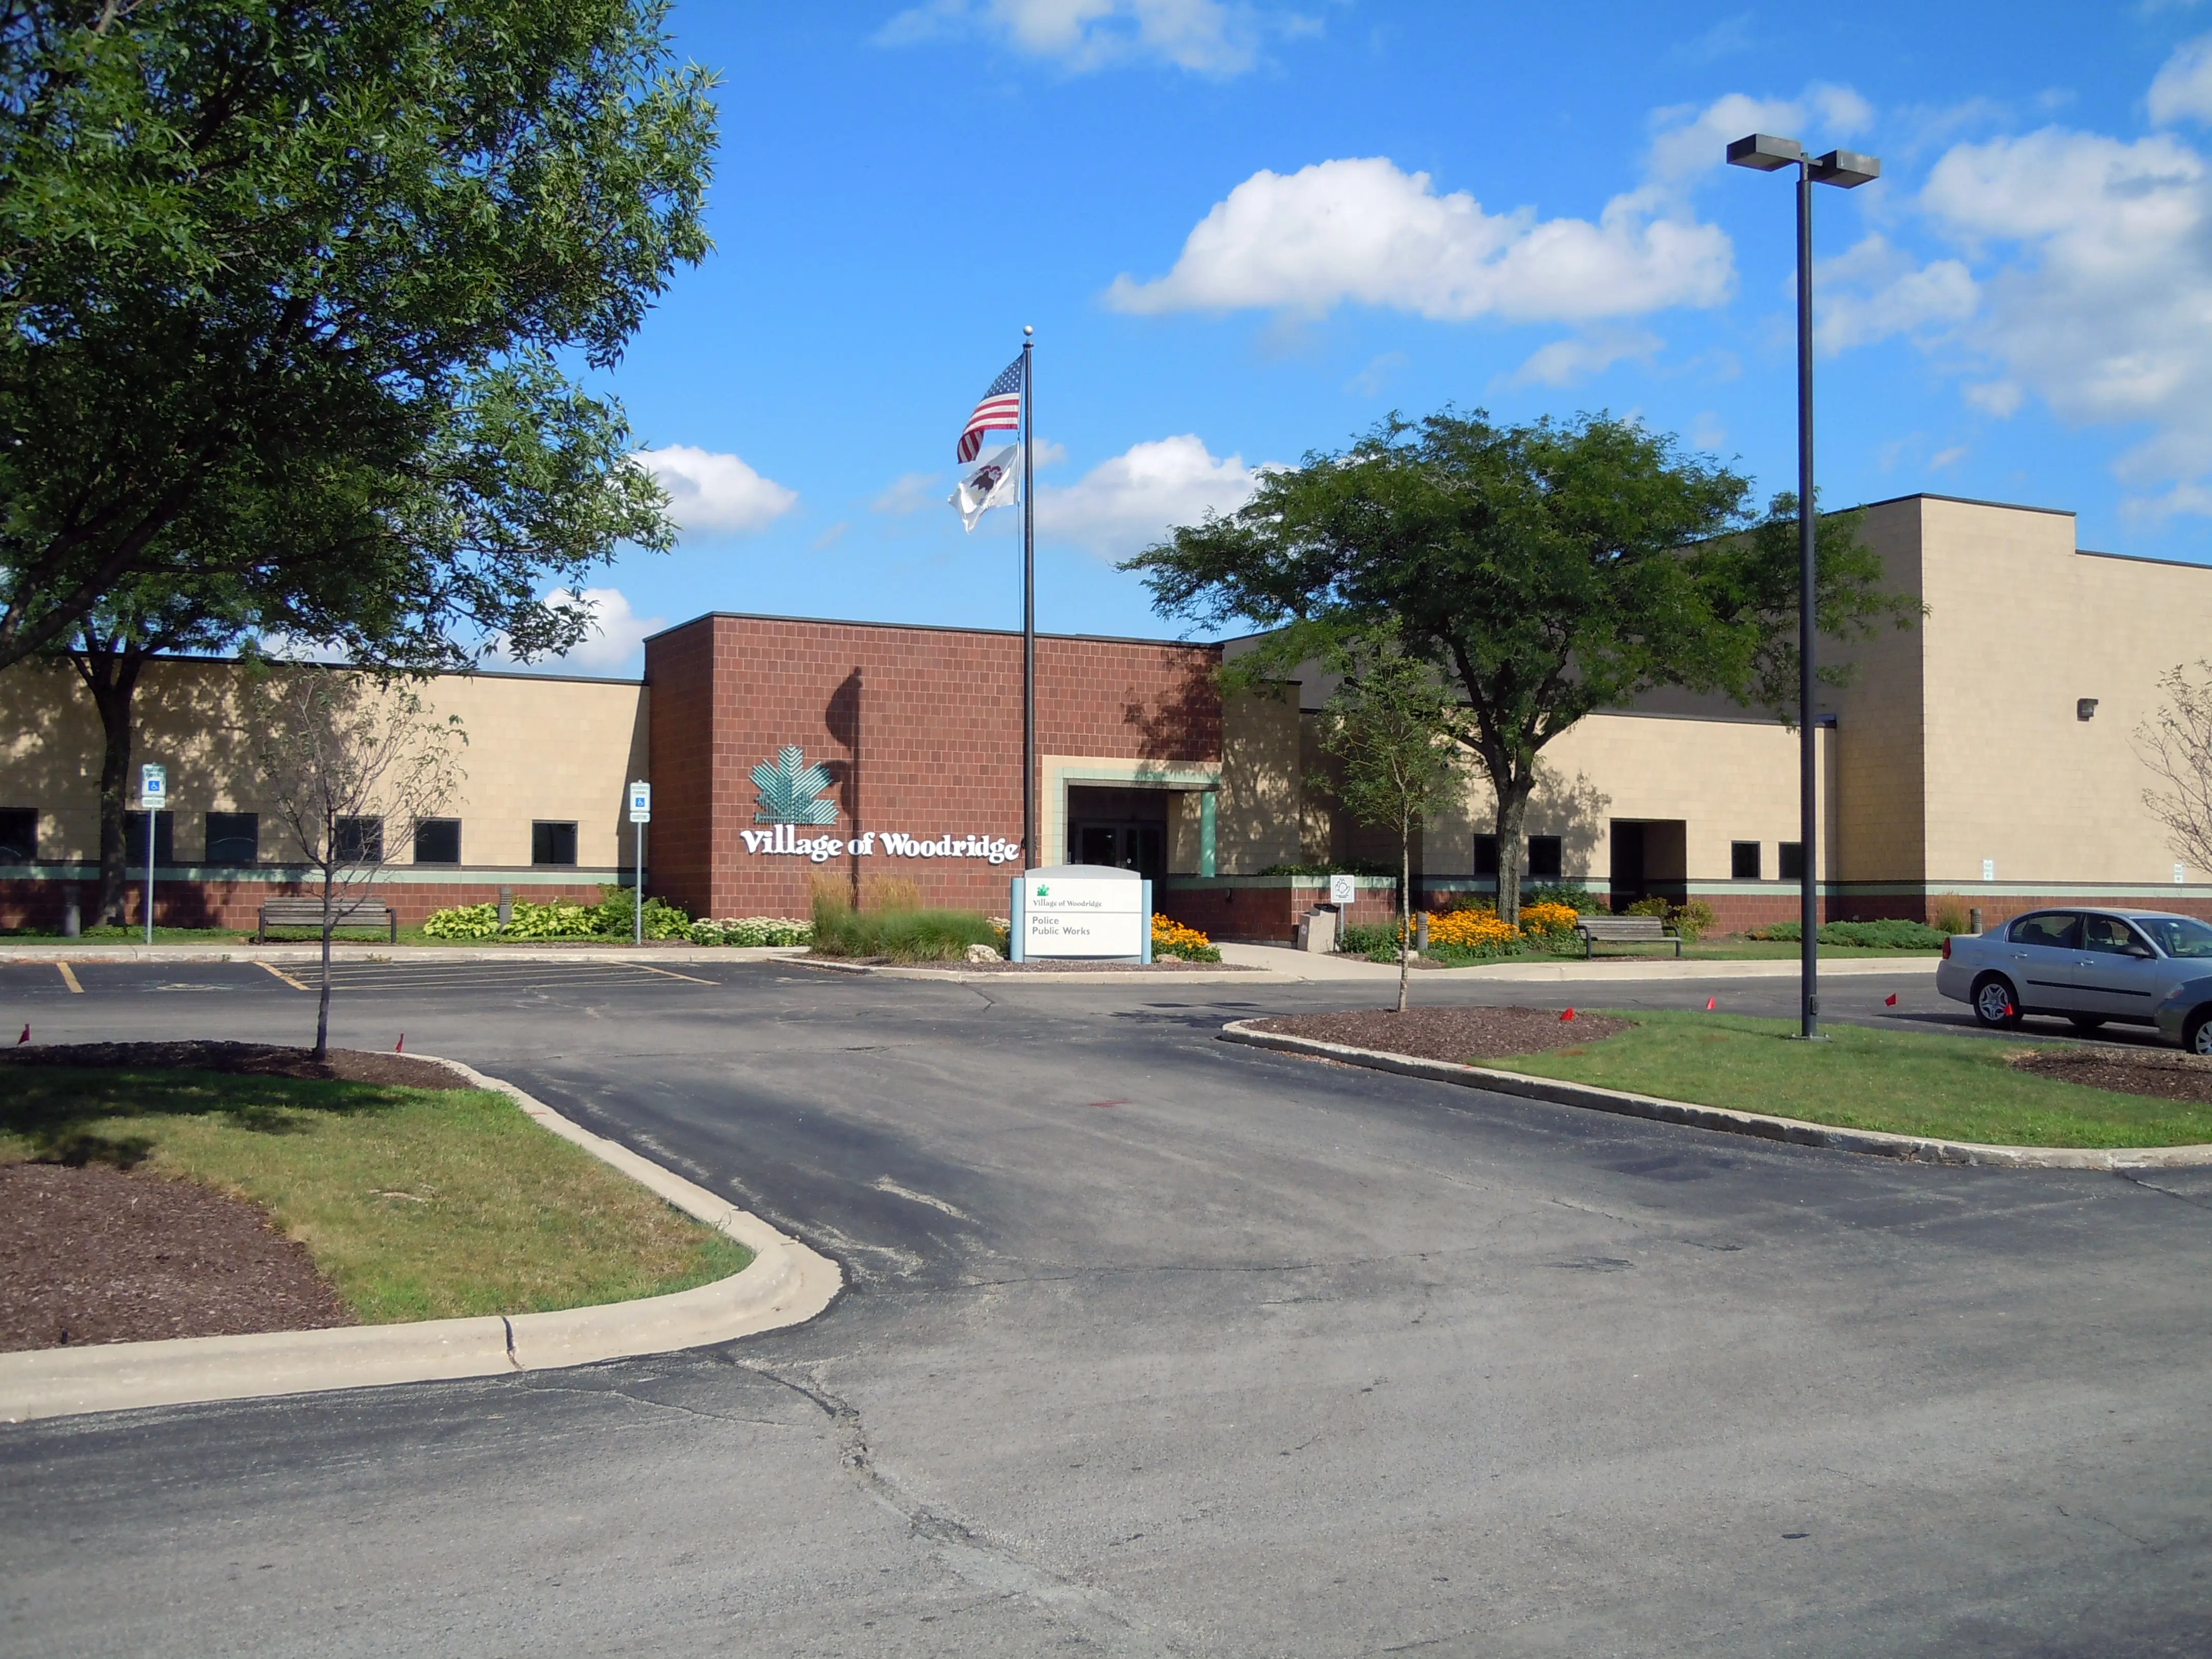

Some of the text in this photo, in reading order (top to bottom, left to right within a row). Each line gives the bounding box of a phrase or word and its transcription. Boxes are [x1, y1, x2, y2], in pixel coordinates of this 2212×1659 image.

[740, 824, 1019, 865] Village of Woodridge
[1033, 898, 1057, 907] Village
[1032, 916, 1059, 925] Police
[1032, 927, 1091, 935] Public Works
